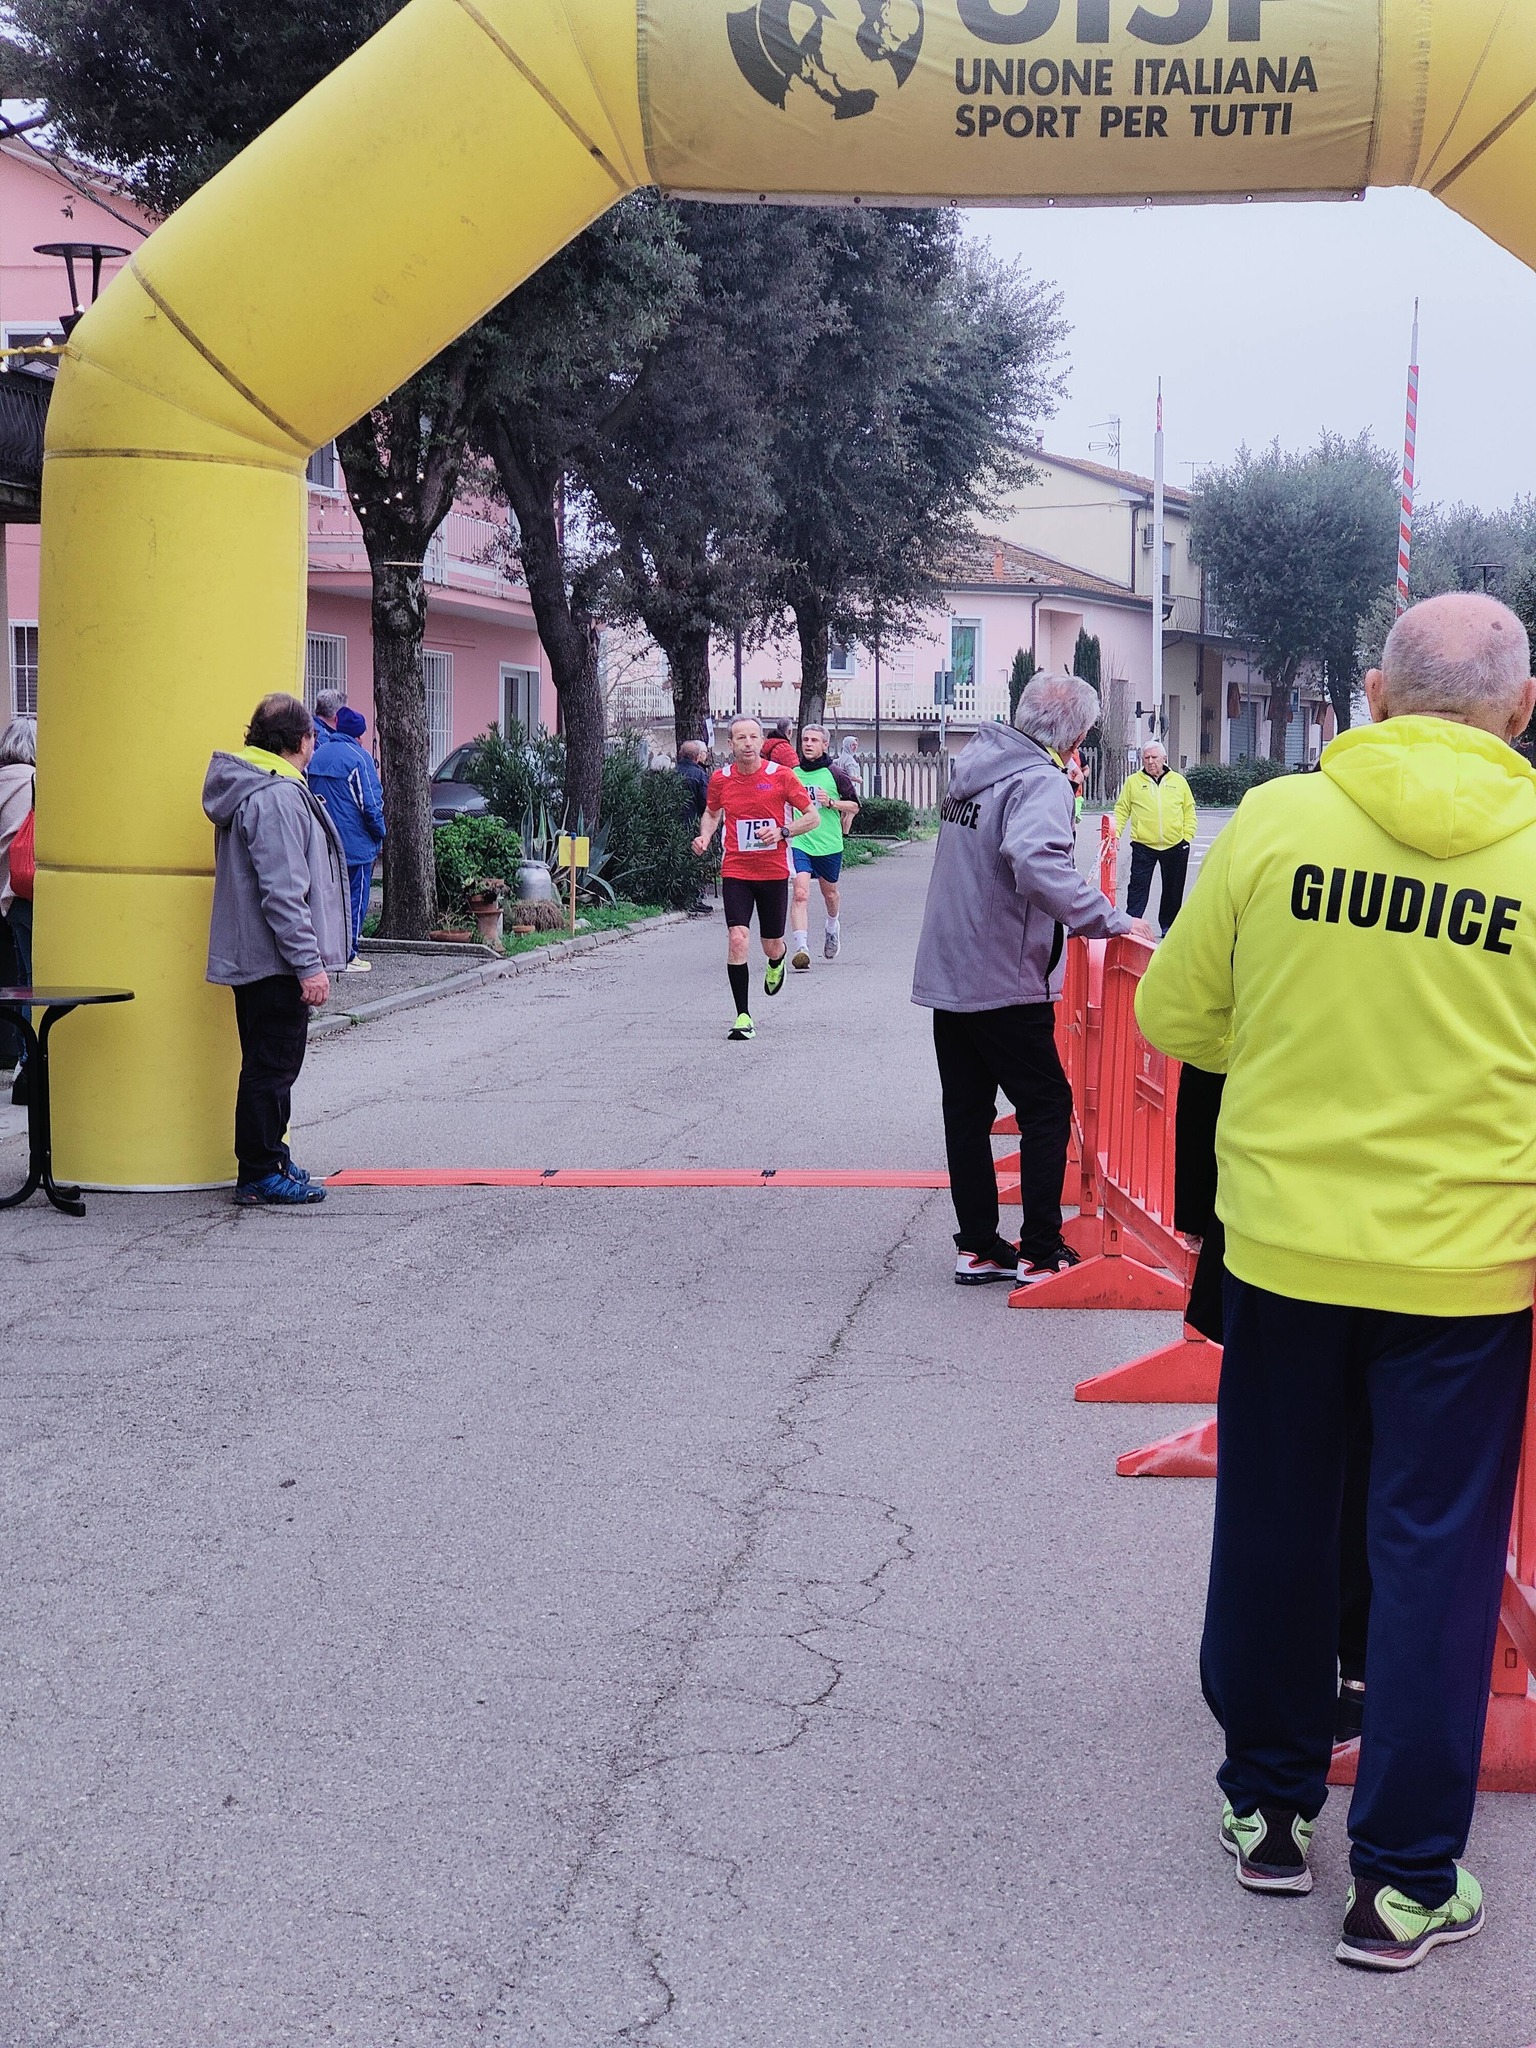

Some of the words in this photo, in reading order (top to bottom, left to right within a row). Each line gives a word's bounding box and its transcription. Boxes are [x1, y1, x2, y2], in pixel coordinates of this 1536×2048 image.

[955, 58, 1114, 96] UNIONE
[1133, 56, 1319, 96] ITALIANA
[954, 104, 1082, 138] SPORT
[1100, 105, 1169, 138] PER
[1190, 102, 1293, 138] TUTTI
[1290, 863, 1522, 956] GIUDICE
